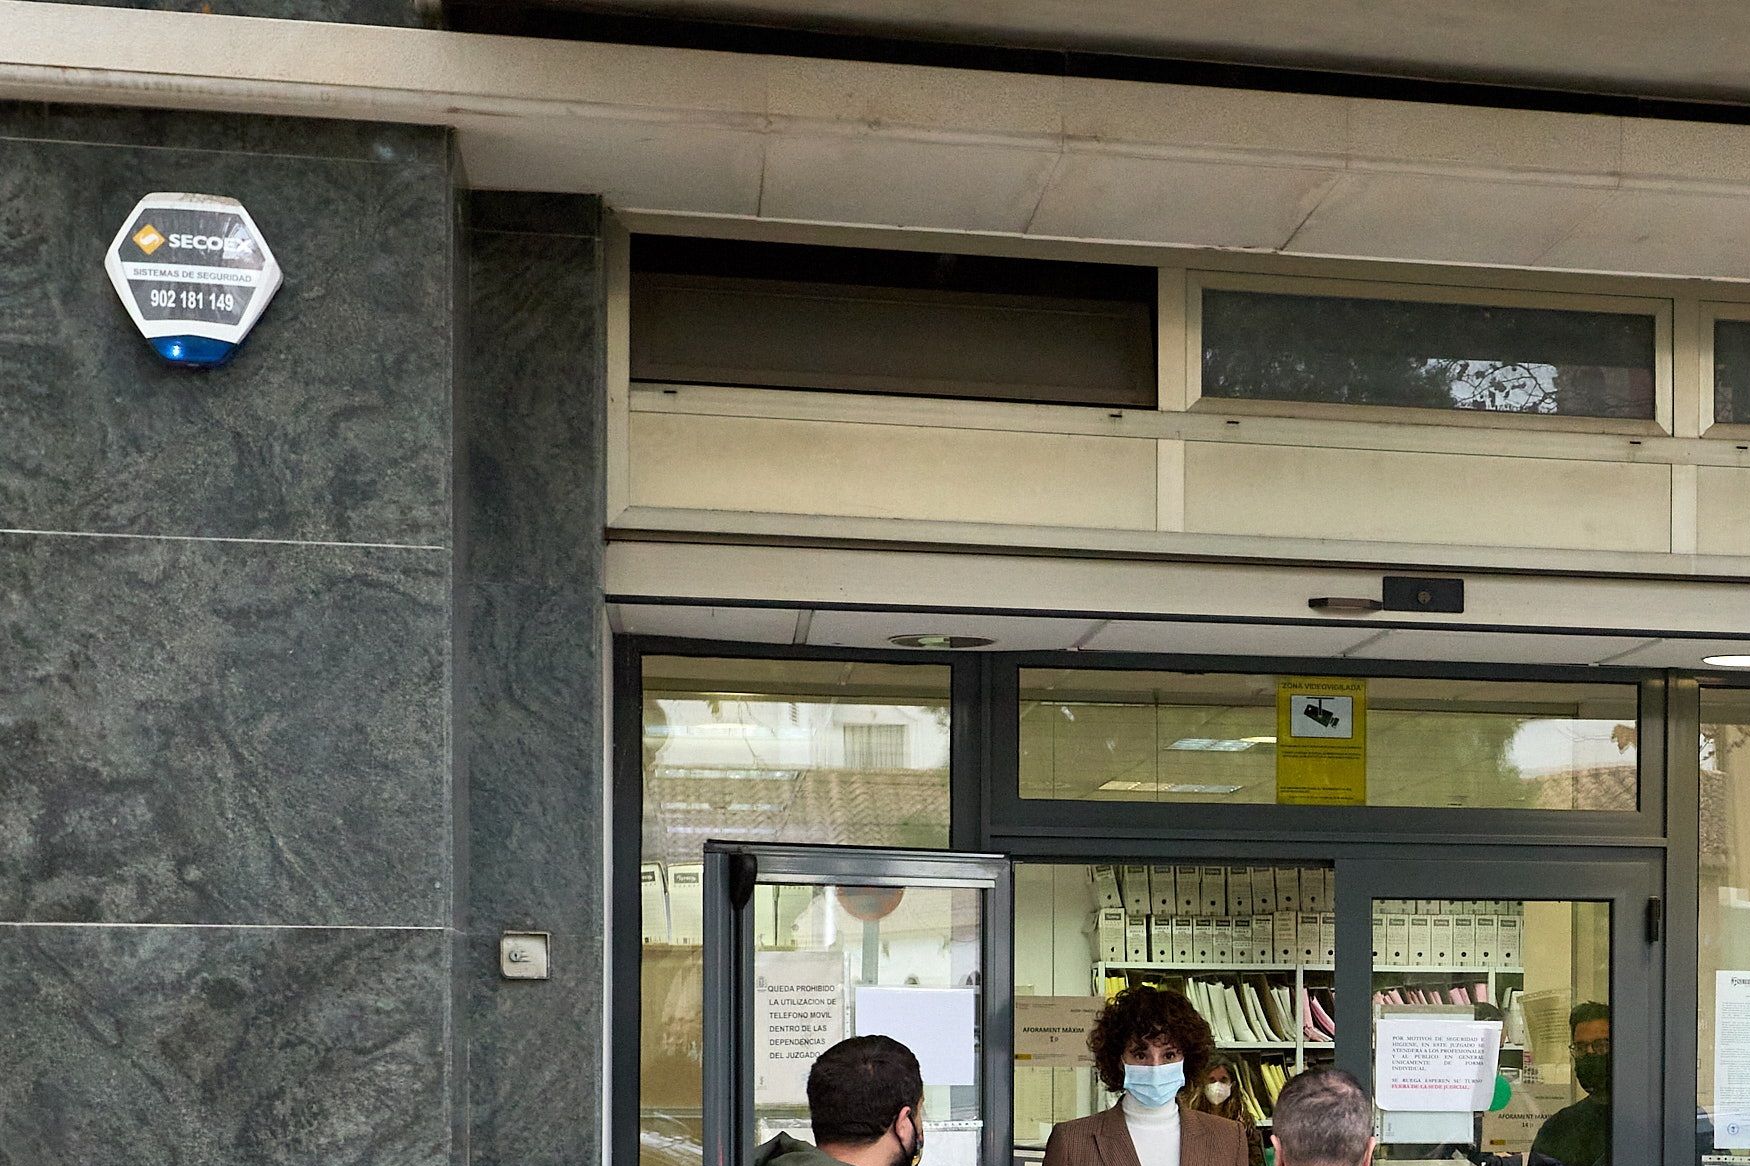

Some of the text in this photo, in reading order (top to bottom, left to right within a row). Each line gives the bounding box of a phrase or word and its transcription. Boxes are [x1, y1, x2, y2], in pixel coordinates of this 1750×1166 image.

[134, 268, 252, 282] SISTEMAS DE SEGURIDAD
[150, 290, 234, 311] 902 181 149
[1305, 683, 1361, 691] VIDEOVIGILADA
[770, 1038, 825, 1046] DEPENDENCIAS
